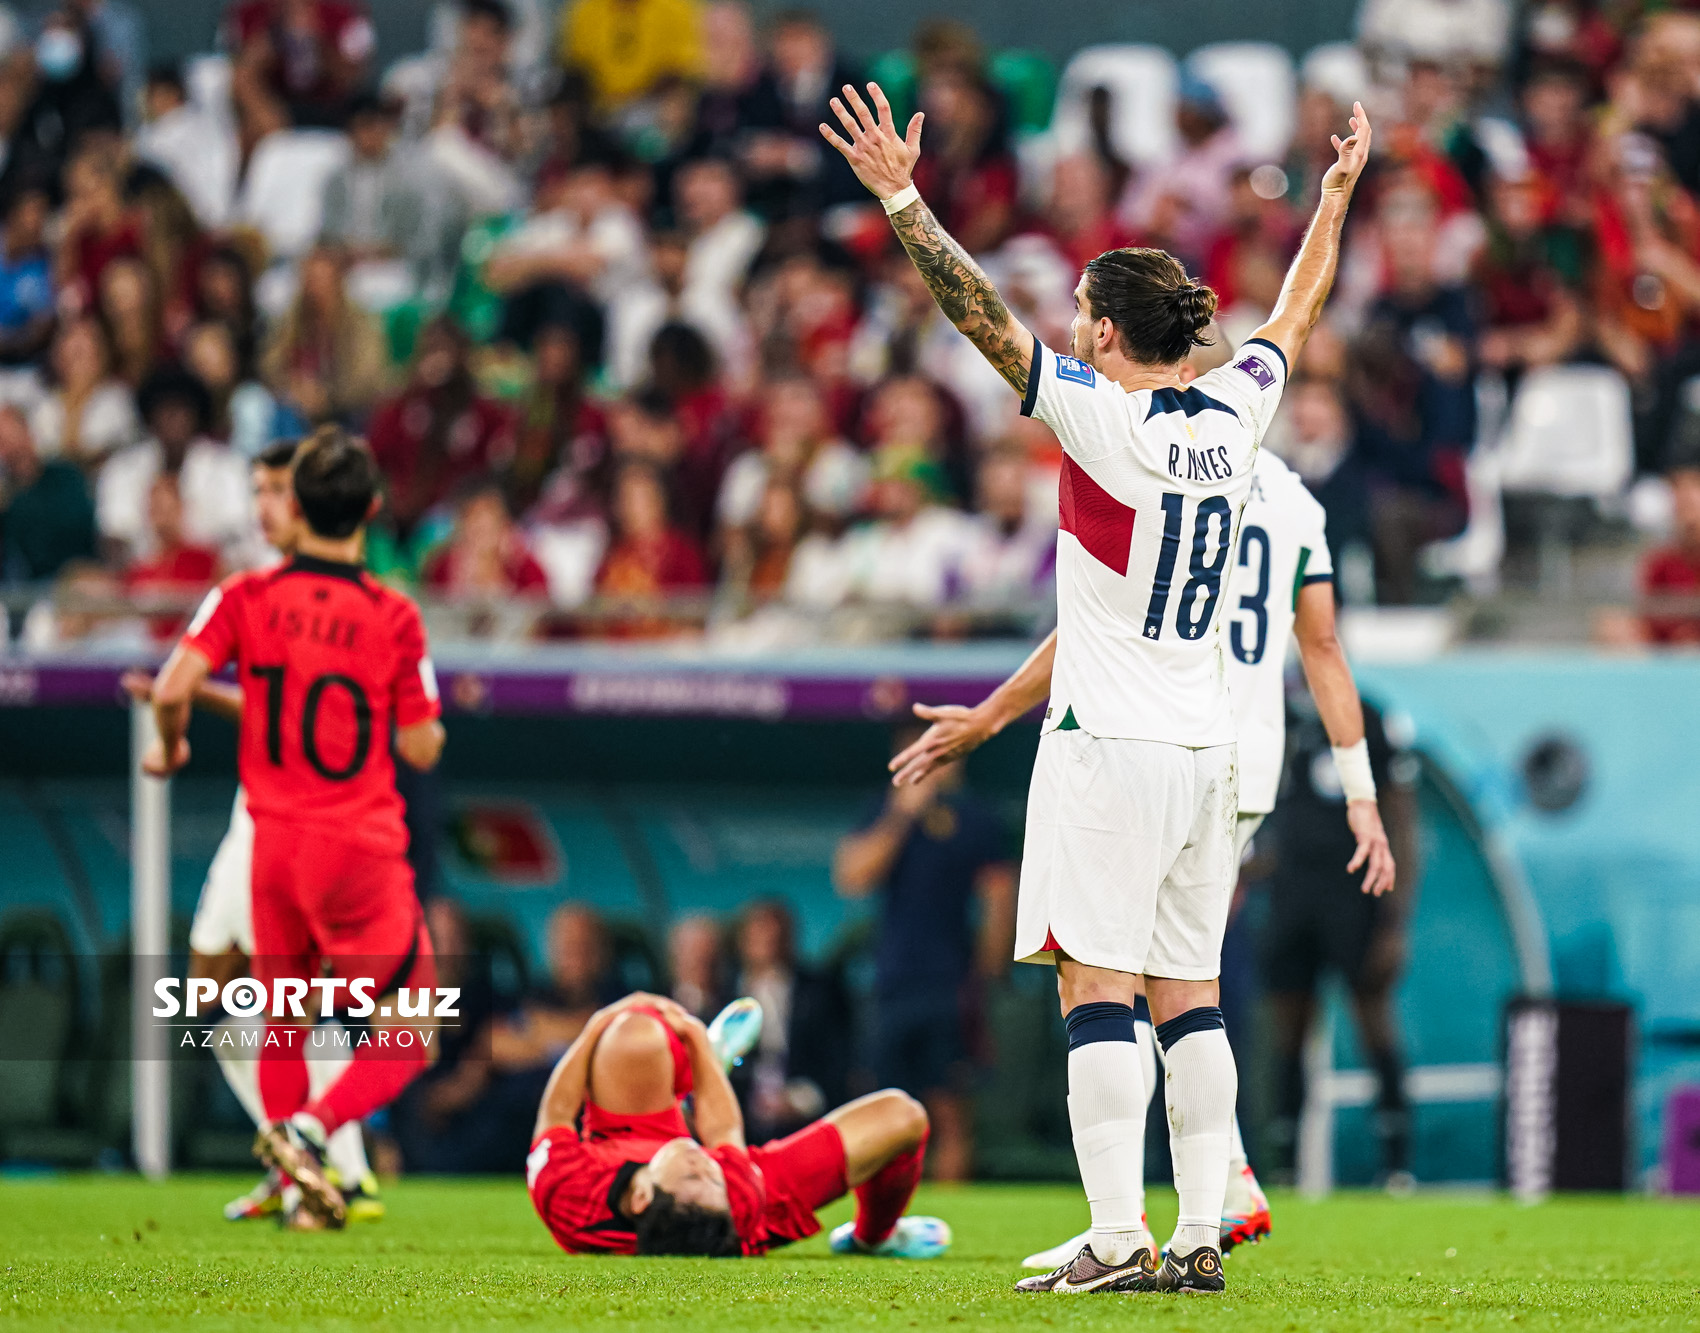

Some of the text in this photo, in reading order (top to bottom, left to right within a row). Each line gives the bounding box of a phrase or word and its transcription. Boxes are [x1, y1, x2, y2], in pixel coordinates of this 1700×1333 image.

[1168, 443, 1182, 478] R.
[1142, 492, 1231, 641] 18
[1230, 525, 1270, 665] 3
[251, 665, 371, 782] 10
